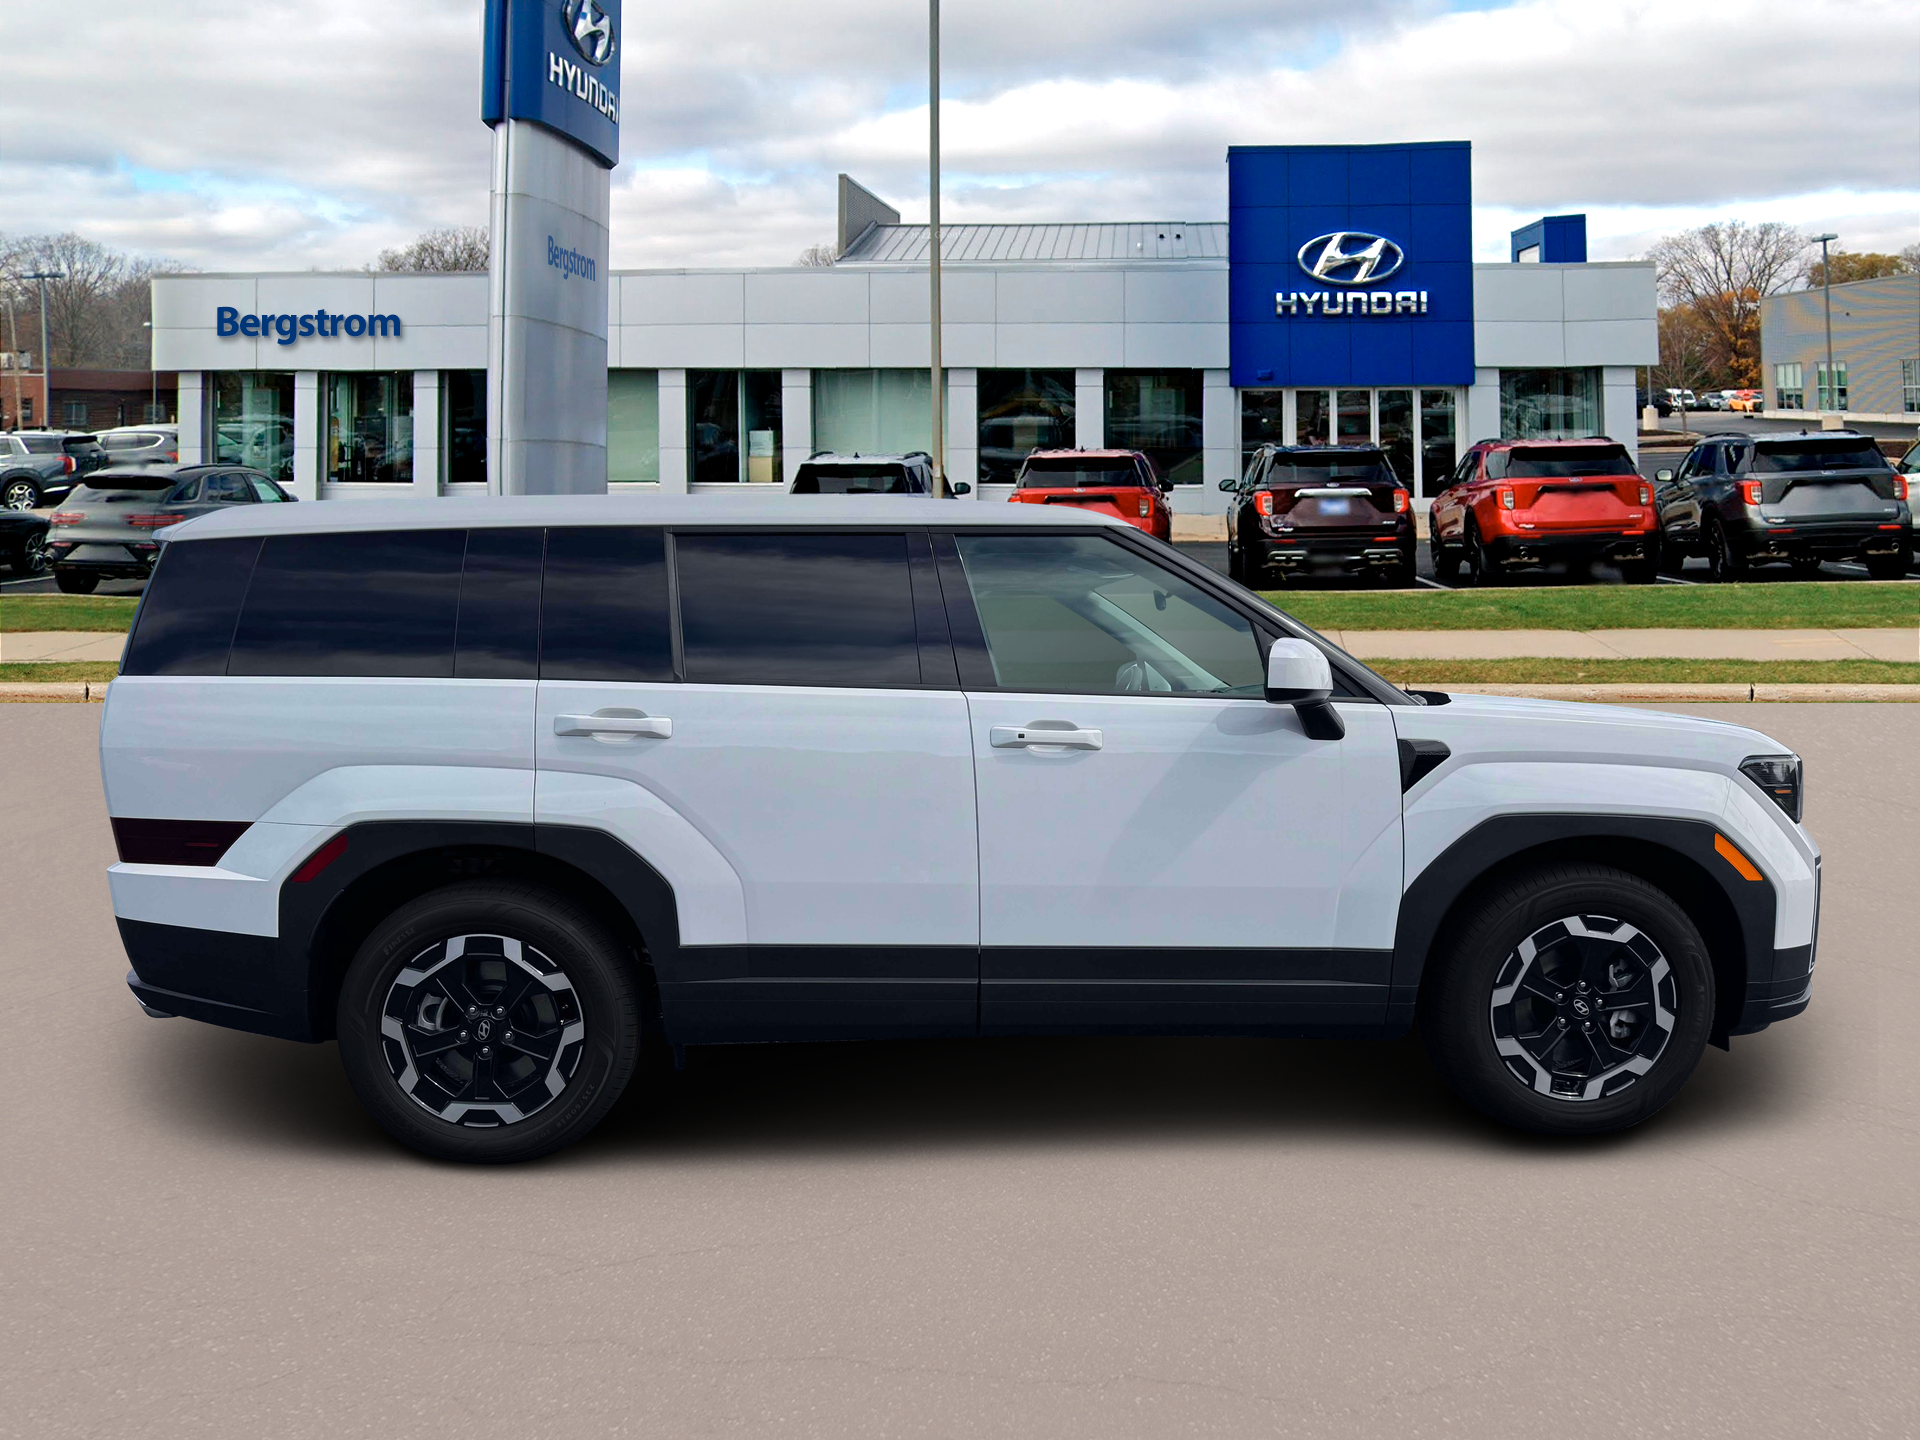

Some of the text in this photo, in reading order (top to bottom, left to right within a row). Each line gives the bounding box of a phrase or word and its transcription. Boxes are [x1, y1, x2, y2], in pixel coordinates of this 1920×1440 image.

[548, 52, 619, 124] HYUNDAI
[547, 235, 596, 282] Bergstrom
[1275, 290, 1428, 315] HYUNDAI
[216, 306, 402, 346] Bergstrom
